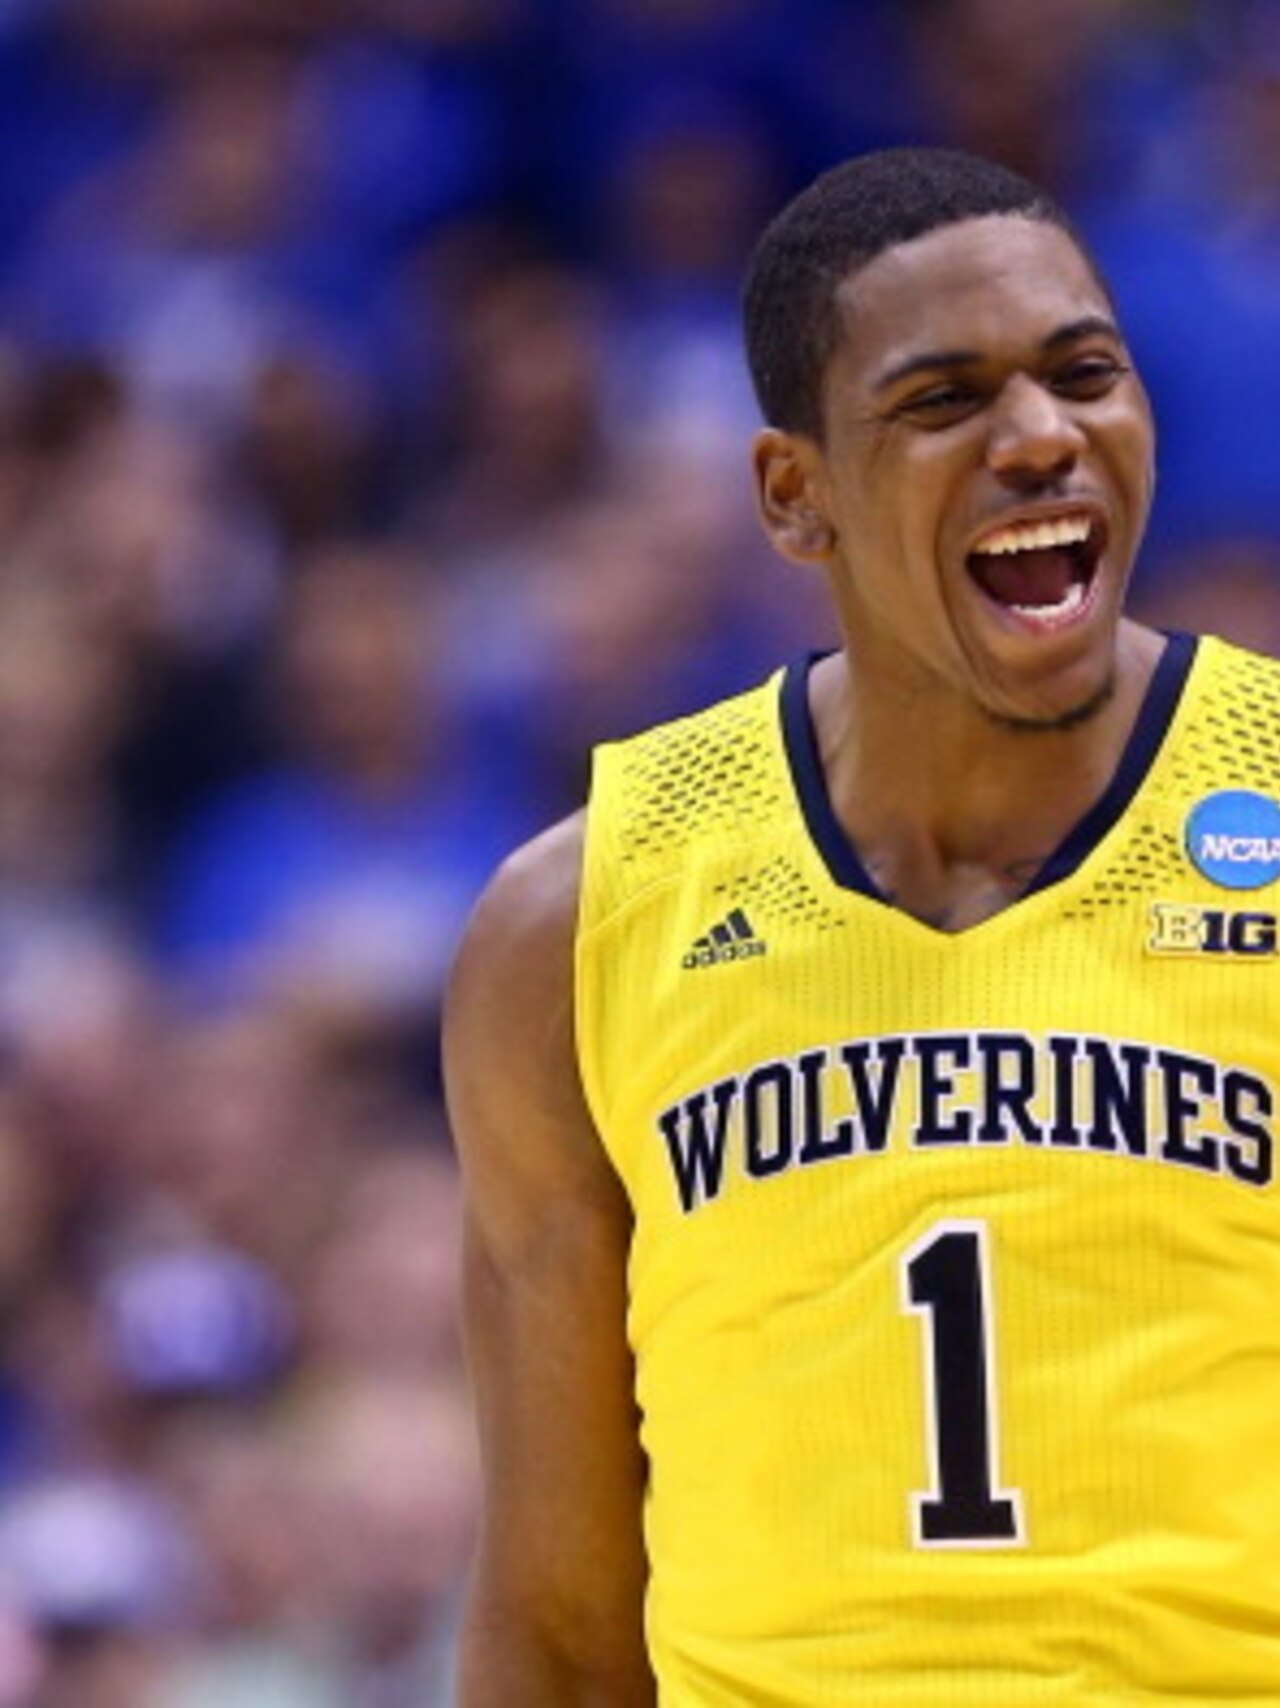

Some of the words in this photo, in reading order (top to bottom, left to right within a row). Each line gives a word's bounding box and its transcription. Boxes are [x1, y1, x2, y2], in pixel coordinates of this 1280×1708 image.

[681, 940, 767, 969] adidas
[1151, 905, 1279, 955] BIG
[659, 1032, 1274, 1213] WOLVERINES
[901, 1220, 1026, 1548] 1
